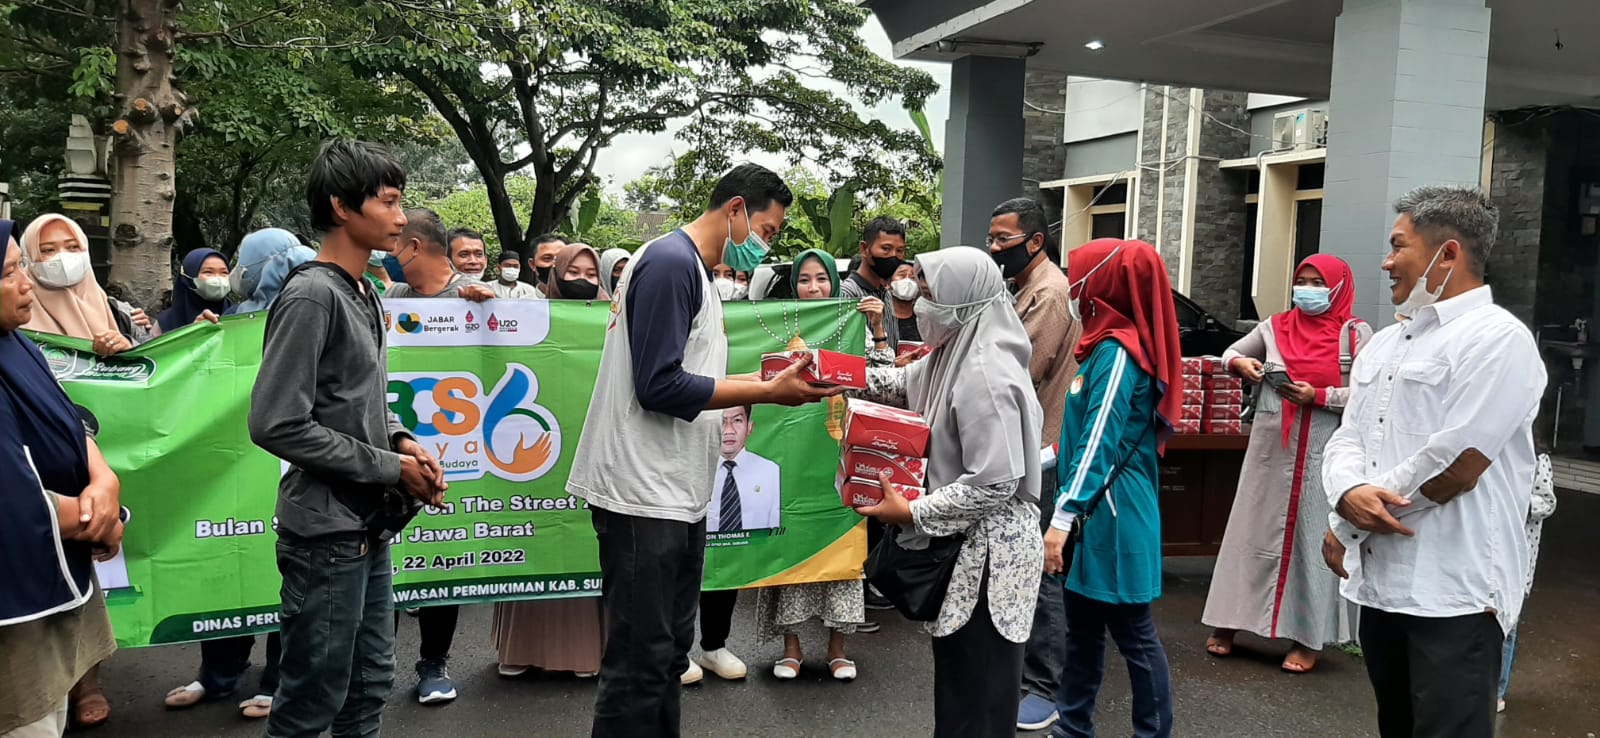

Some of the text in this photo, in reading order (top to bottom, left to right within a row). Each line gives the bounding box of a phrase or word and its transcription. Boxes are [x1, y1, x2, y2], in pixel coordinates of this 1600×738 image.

[424, 325, 459, 334] Bergerak
[461, 495, 504, 514] The
[509, 495, 578, 513] Street
[195, 517, 265, 538] Bulan
[407, 526, 468, 543] Jawa
[474, 521, 534, 539] Barat
[402, 555, 427, 571] 22
[430, 552, 476, 571] April
[479, 550, 526, 565] 2022
[452, 580, 545, 597] PERMUKIMAN
[549, 579, 580, 592] KAB.
[583, 578, 603, 590] SU
[192, 616, 242, 633] DINAS
